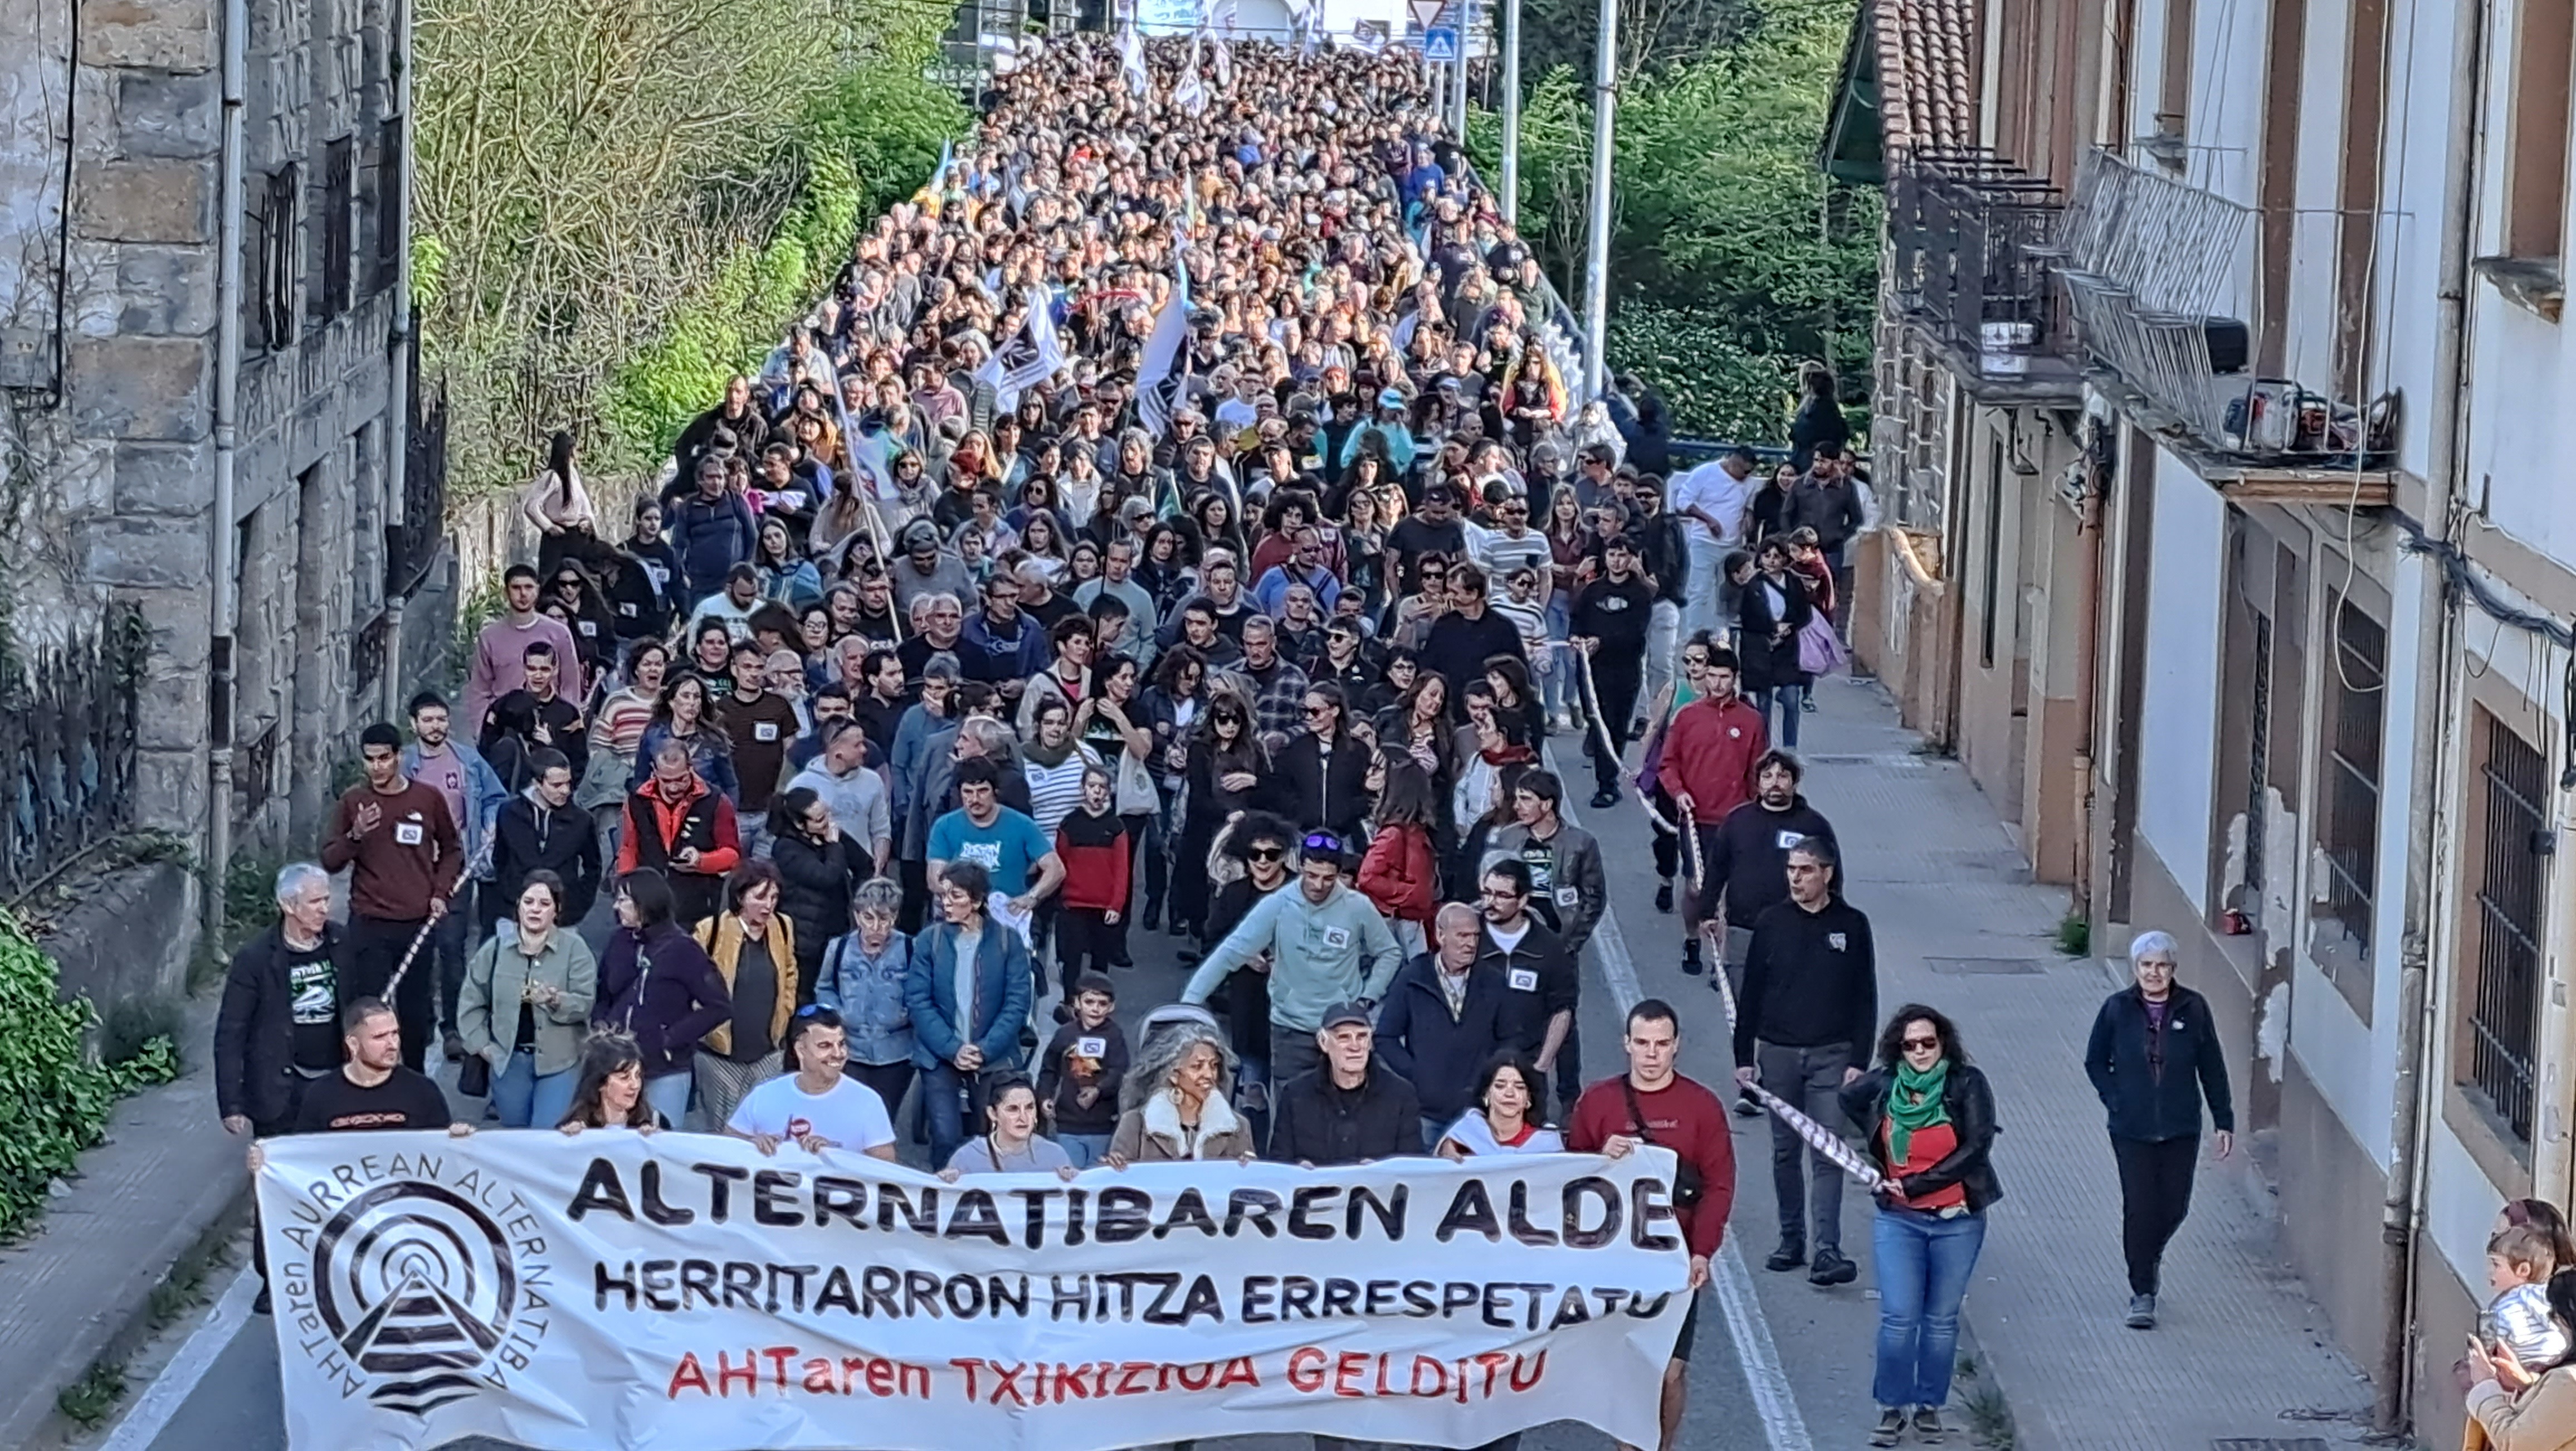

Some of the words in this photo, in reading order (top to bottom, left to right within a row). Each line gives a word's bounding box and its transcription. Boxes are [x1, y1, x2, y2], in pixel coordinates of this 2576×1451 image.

[282, 1152, 443, 1250] AURREAN
[566, 1157, 1409, 1250] ALTERNATIBAREN
[1436, 1176, 1680, 1251] ALDE
[454, 1169, 554, 1391] ALTERNATIBA
[594, 1259, 1030, 1319] HERRITARRON
[1051, 1272, 1225, 1326] HITZA
[1242, 1275, 1672, 1331] ERRESPETATU
[282, 1262, 367, 1399] AHTaren
[667, 1346, 930, 1400] AHTaren
[1287, 1346, 1548, 1404] GELDITU
